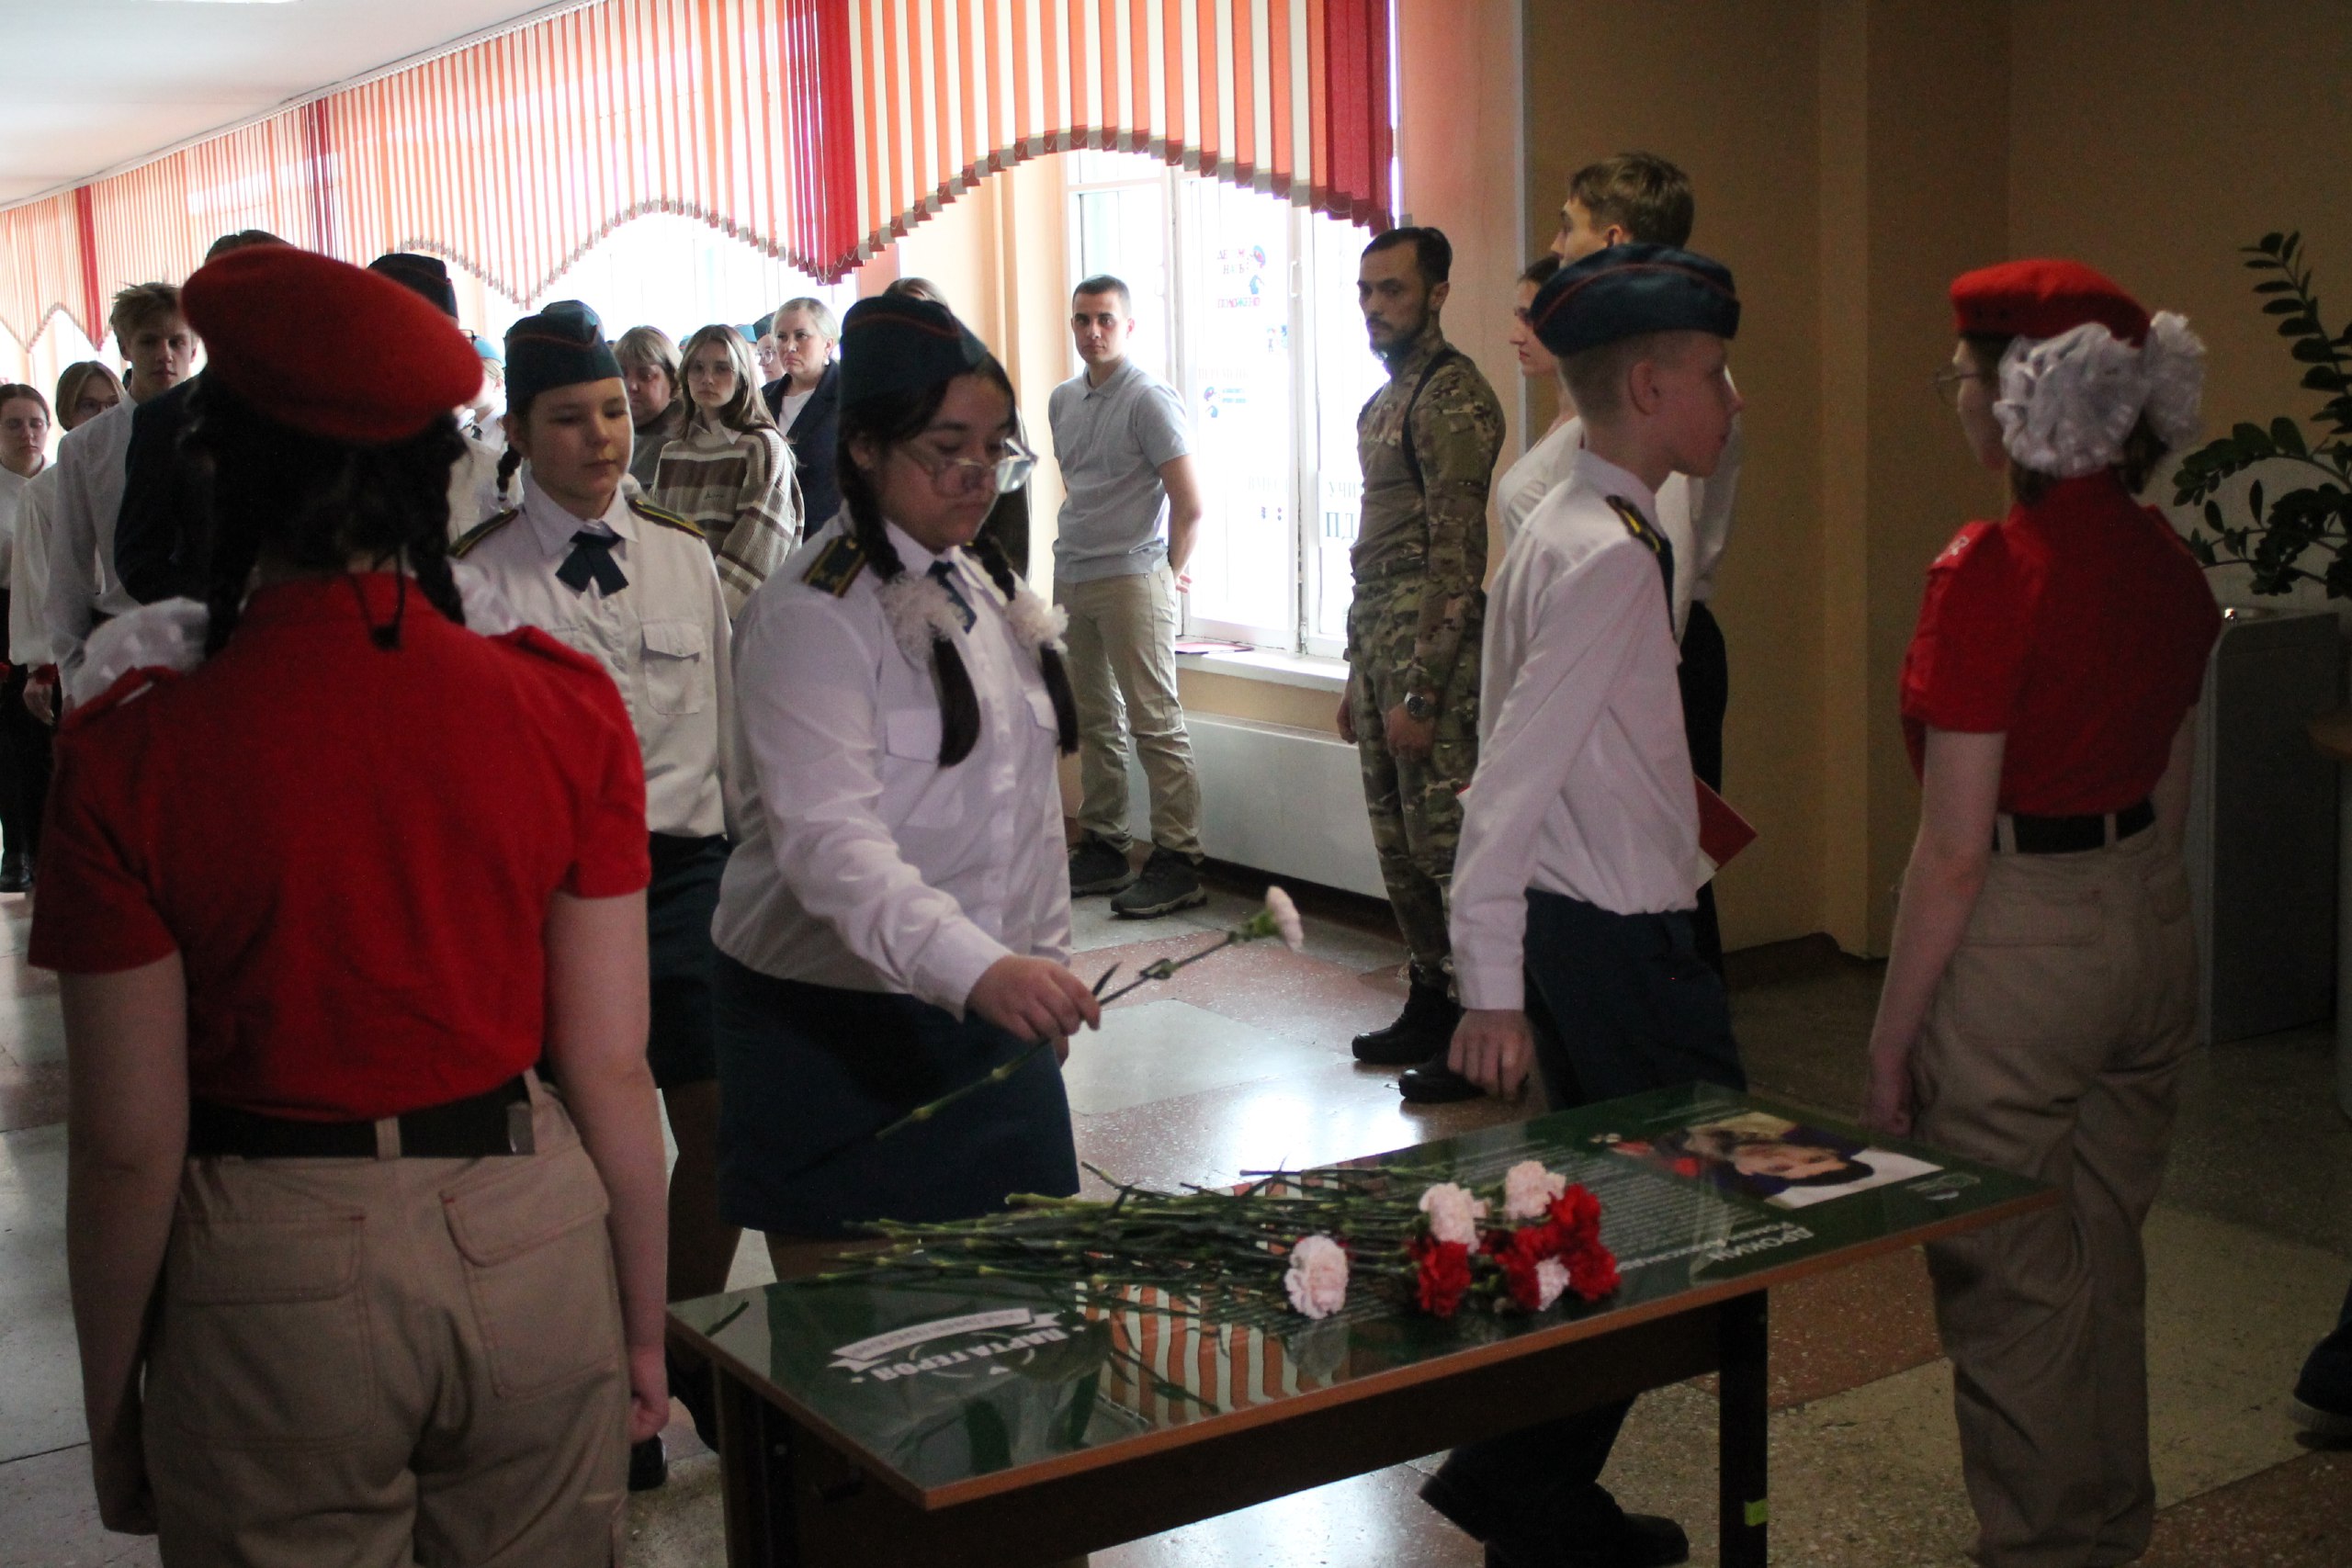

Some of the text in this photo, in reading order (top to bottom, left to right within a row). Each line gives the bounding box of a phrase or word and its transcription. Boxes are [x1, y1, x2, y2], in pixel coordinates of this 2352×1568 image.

[1329, 480, 1363, 499] УЧИ
[1326, 512, 1357, 541] ПД
[967, 1327, 1069, 1357] ПАРТА
[869, 1350, 969, 1382] ГЕРОЯ
